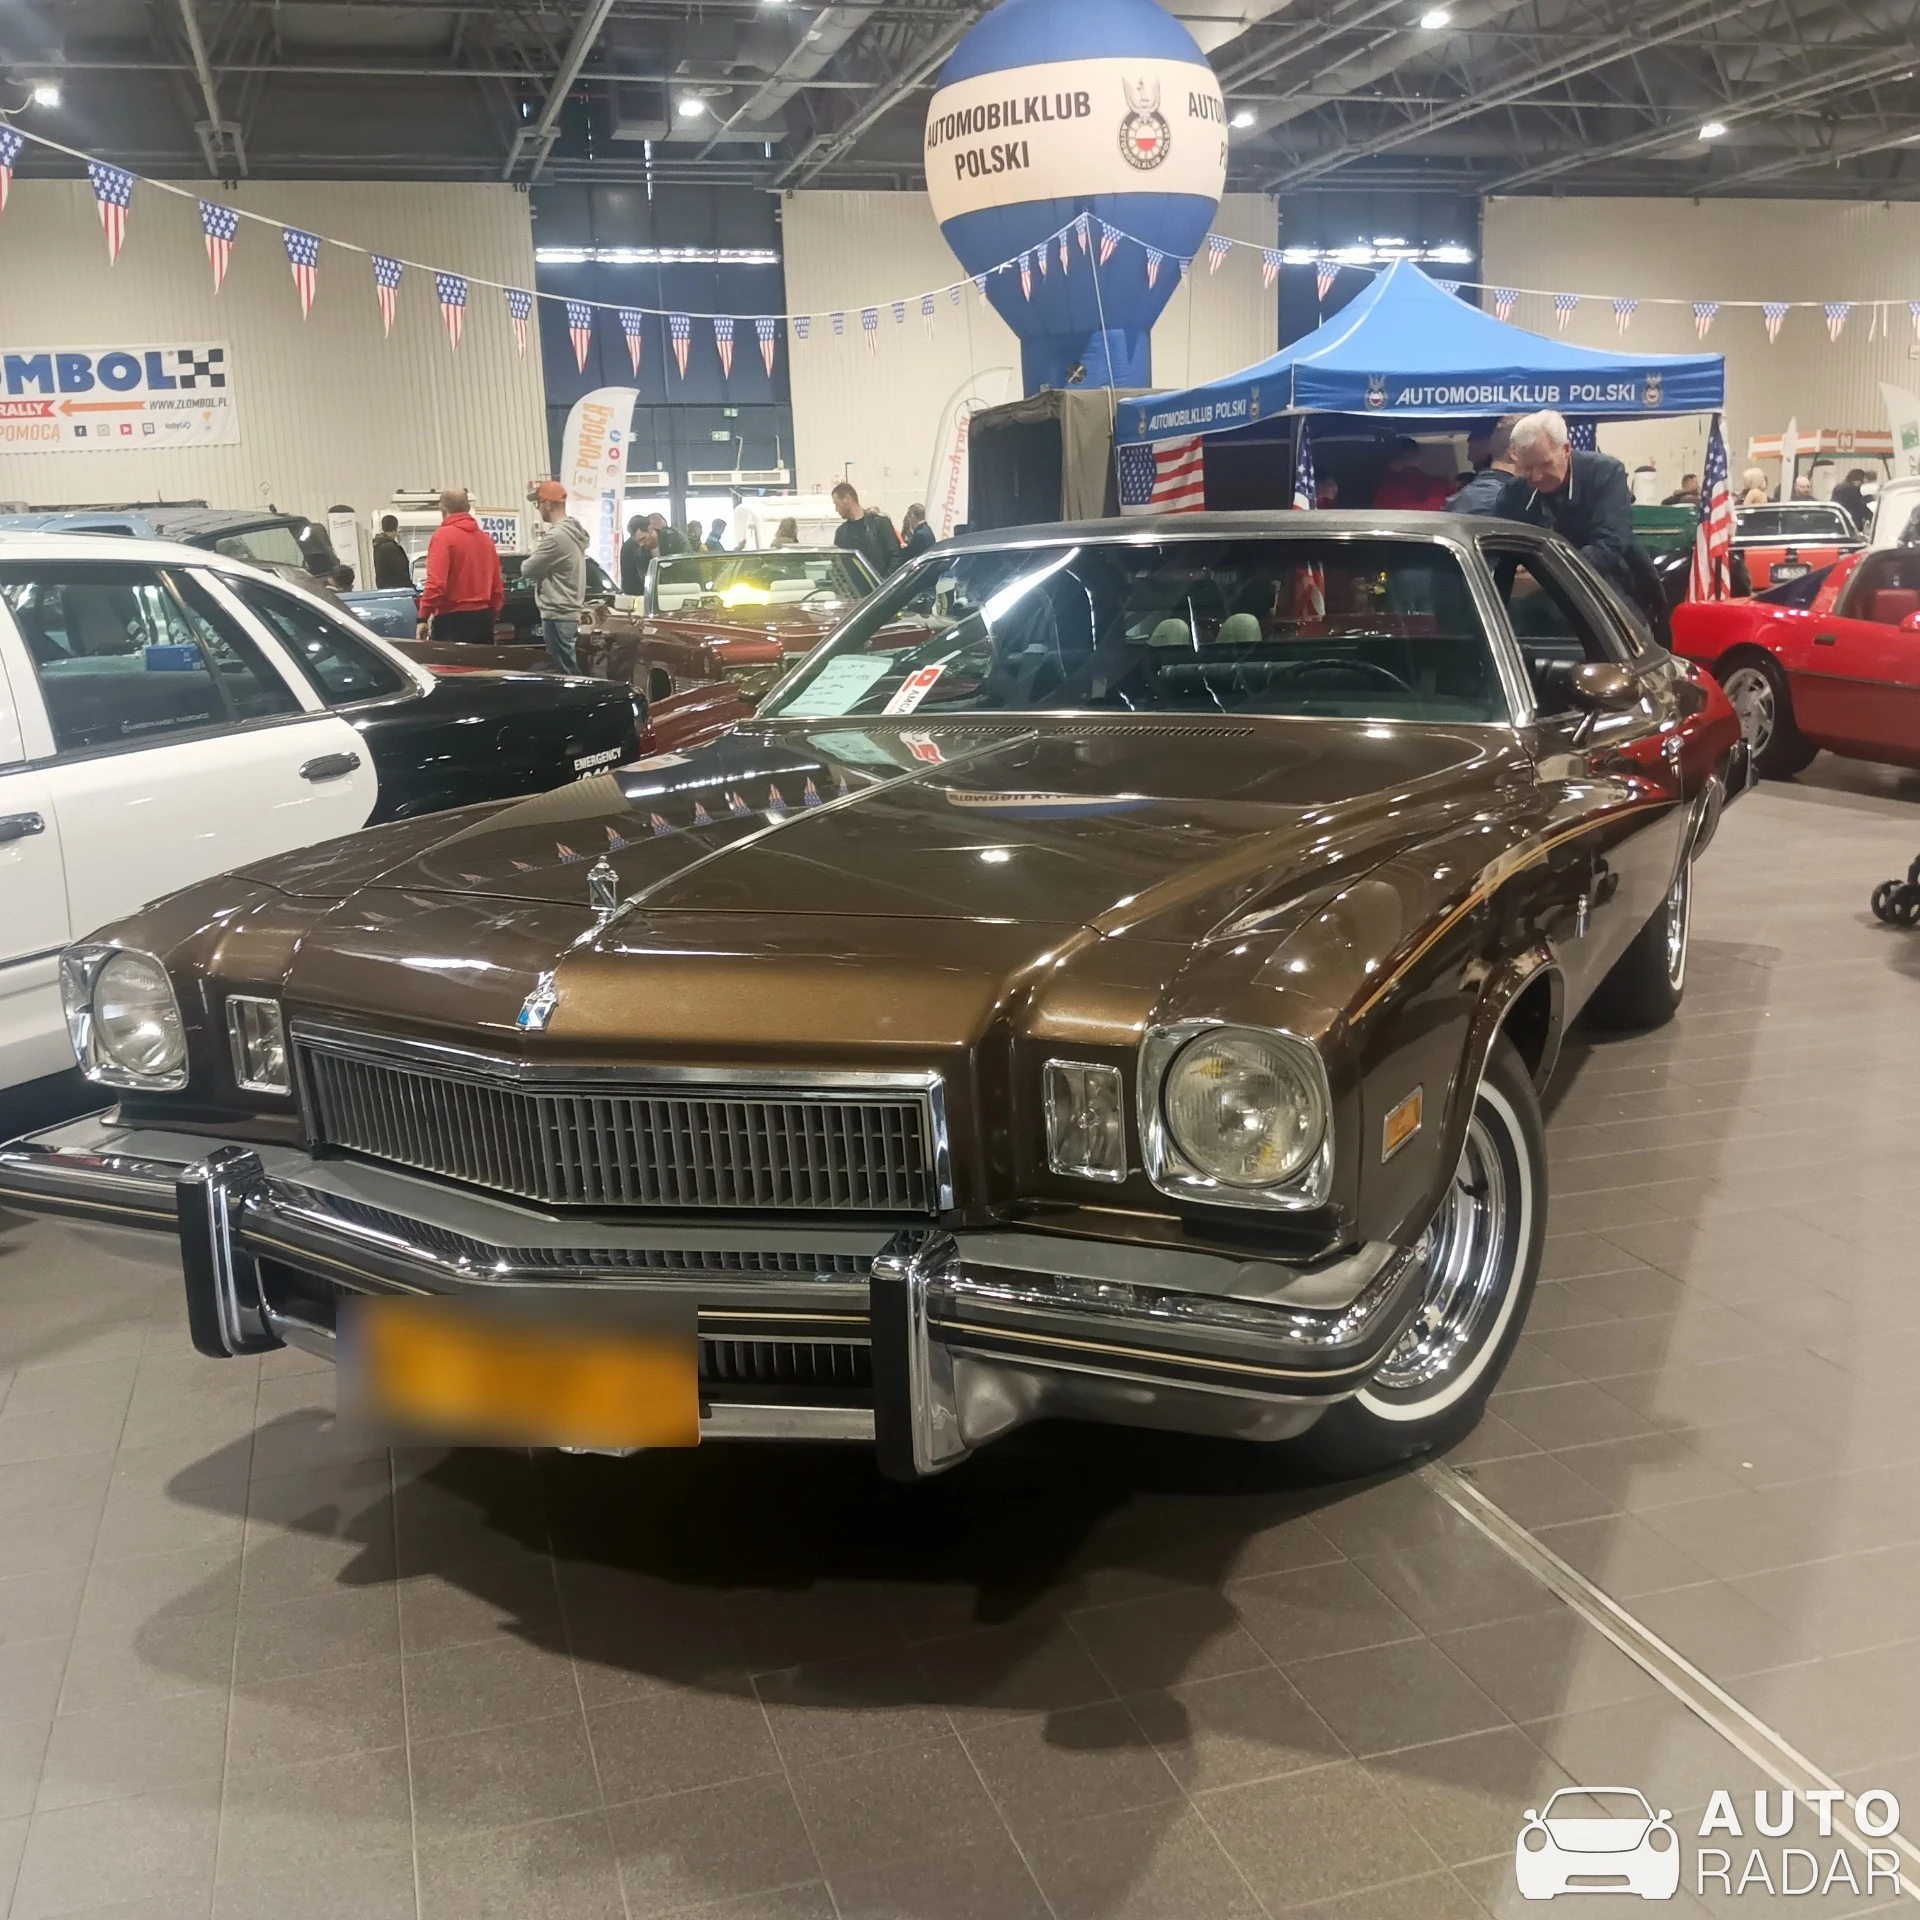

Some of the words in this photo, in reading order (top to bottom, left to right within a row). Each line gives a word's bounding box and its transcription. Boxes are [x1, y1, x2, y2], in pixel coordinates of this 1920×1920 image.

[927, 91, 1091, 151] AUTOMOBILKLUB
[954, 140, 1029, 181] POLSKI
[0, 351, 177, 395] MBOL
[1395, 384, 1560, 407] AUTOMOBILKLUB
[1568, 383, 1636, 402] POLSKI
[1148, 405, 1213, 431] AUTOMOBILKLUB
[1215, 398, 1247, 419] POLSKI
[481, 517, 516, 531] ZŁOM
[574, 746, 622, 772] EMERGENCY
